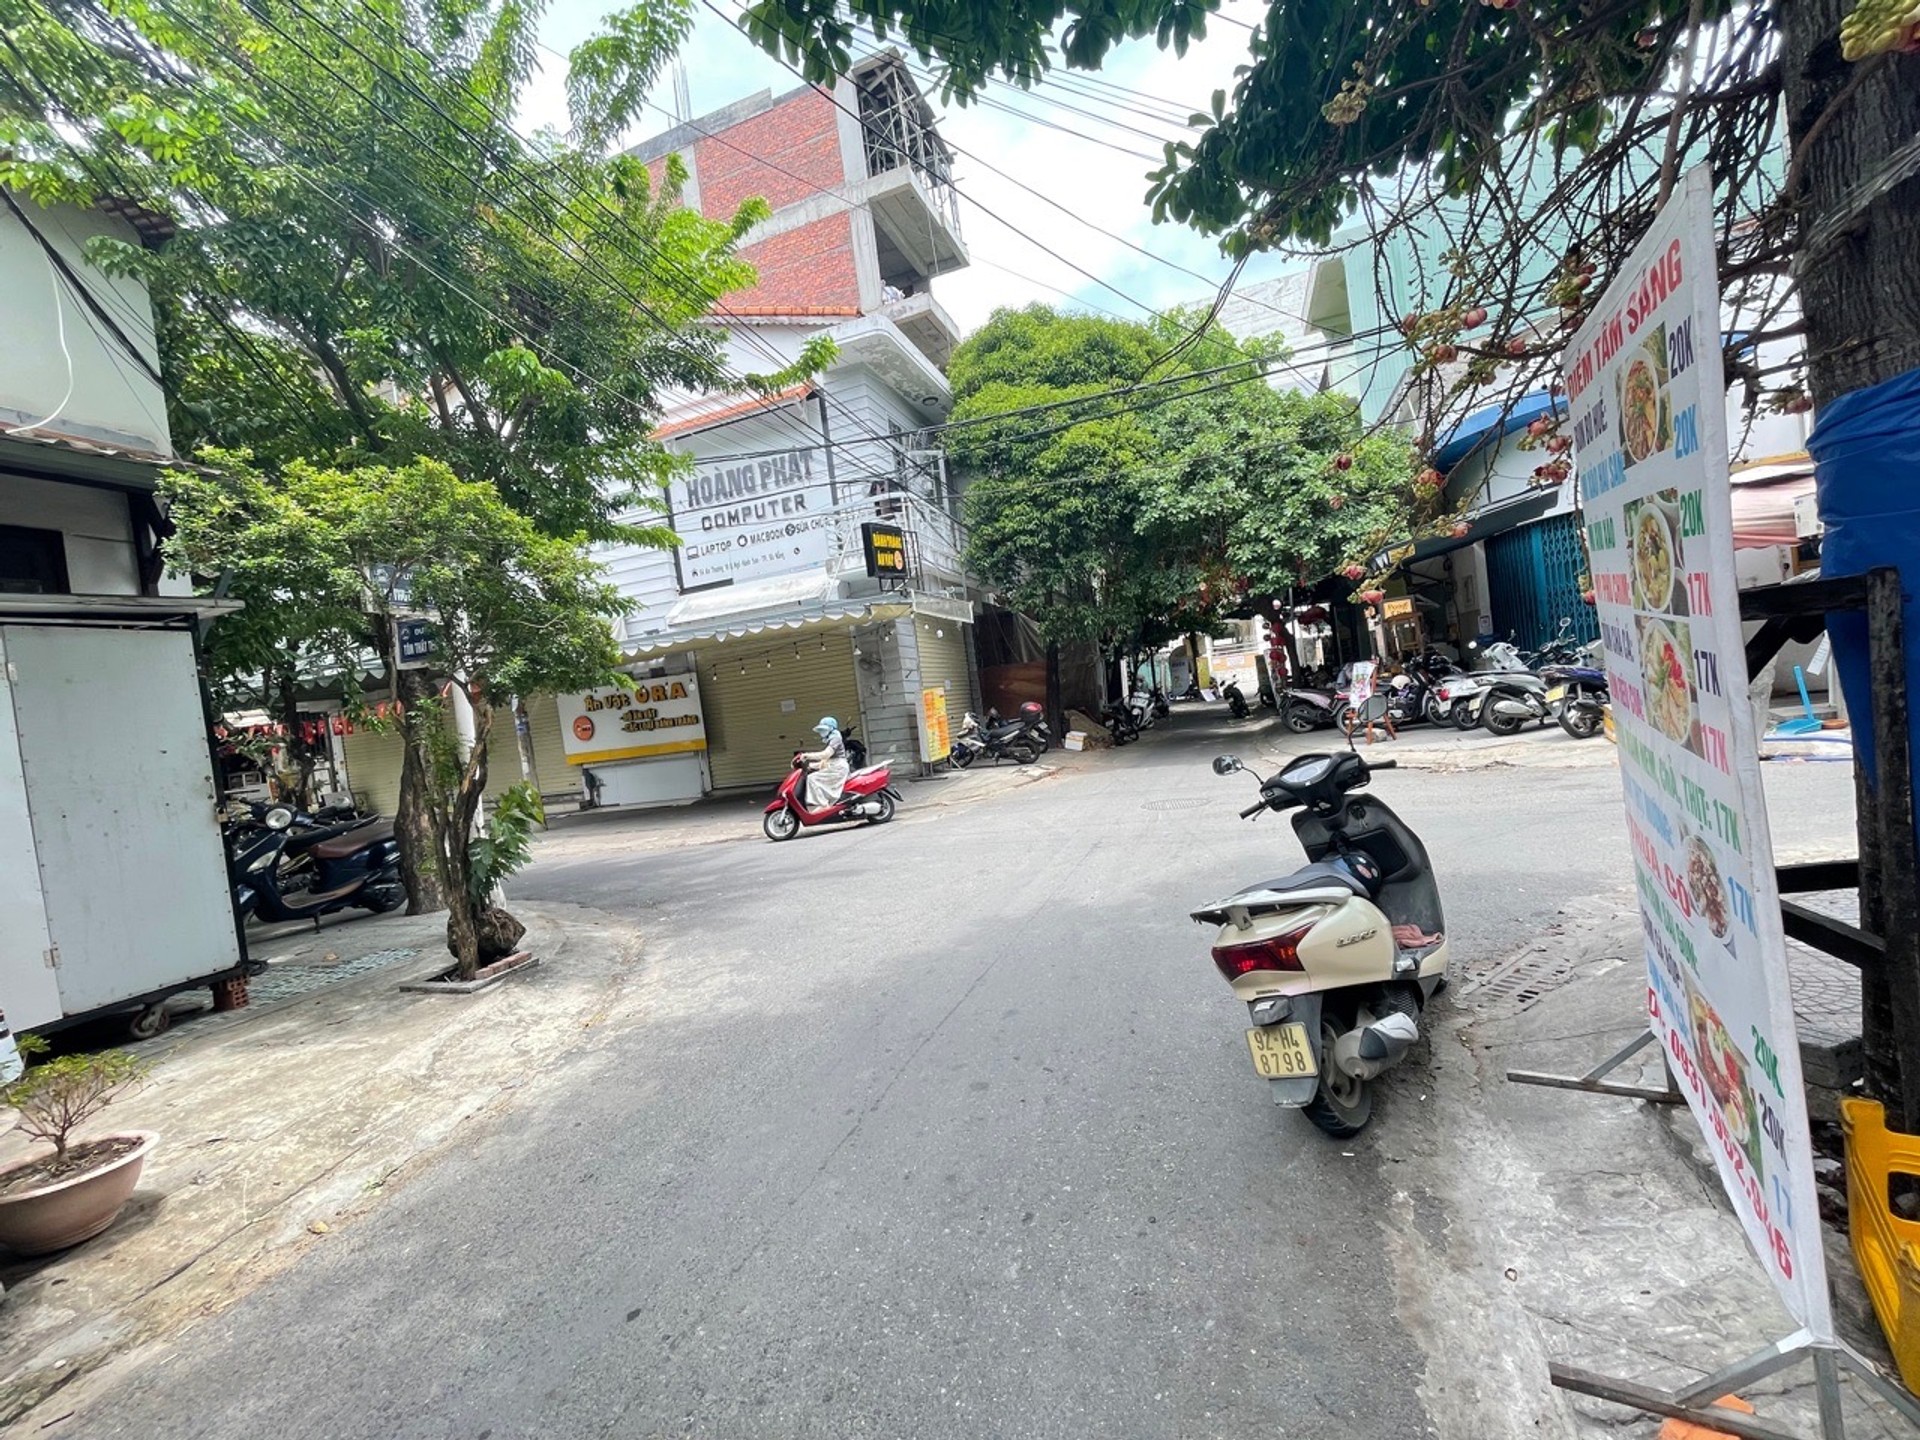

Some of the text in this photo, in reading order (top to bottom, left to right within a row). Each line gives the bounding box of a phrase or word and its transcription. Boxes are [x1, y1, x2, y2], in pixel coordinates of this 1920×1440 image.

[1594, 309, 1624, 371] TÂM
[1626, 238, 1683, 335] SÁNG
[1668, 315, 1695, 379] 20K
[1673, 403, 1699, 460] 20K
[686, 447, 813, 508] HOÀNG PHÁT
[701, 493, 807, 531] COMPUTER
[1680, 489, 1706, 538] 20K
[700, 540, 732, 556] LAPTOP
[749, 530, 786, 545] MACBOOK
[1687, 572, 1713, 618] 17K
[634, 682, 688, 704] ORA
[1694, 649, 1722, 698] 17K
[1701, 723, 1731, 776] 17K
[1681, 774, 1713, 832] THỊT:
[1714, 798, 1743, 855] 17K
[1728, 875, 1758, 940] 17K
[1254, 1027, 1300, 1051] 92-H4
[1260, 1050, 1307, 1074] 8798
[1752, 1024, 1785, 1100] 20K
[1759, 1092, 1790, 1172] 20K
